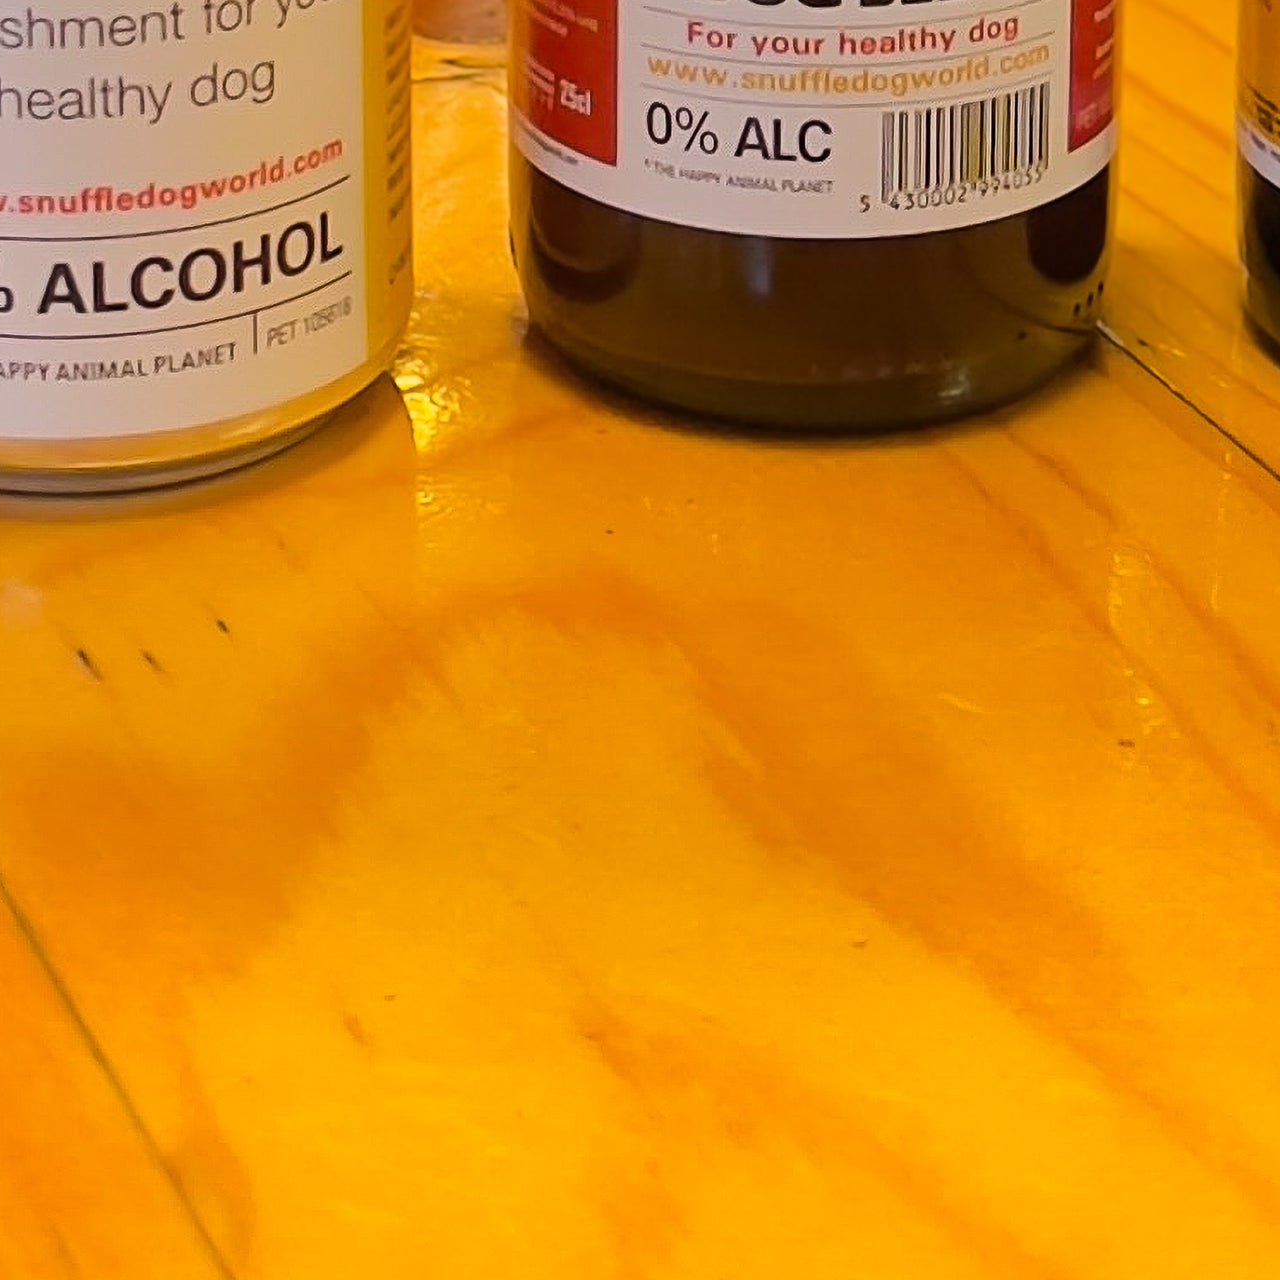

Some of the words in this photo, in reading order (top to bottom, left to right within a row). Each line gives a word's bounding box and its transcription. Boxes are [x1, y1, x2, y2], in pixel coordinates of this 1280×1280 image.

[686, 21, 736, 49] For
[751, 31, 825, 58] your
[838, 27, 956, 56] healthy
[968, 14, 1021, 43] dog
[190, 58, 277, 107] dog
[646, 43, 1051, 97] www.snuffledogworld.com
[645, 102, 719, 157] 0%
[734, 115, 832, 162] ALC
[726, 176, 777, 191] ANIMAL
[781, 179, 834, 193] PLANET
[37, 211, 344, 315] ALCOHOL
[56, 358, 148, 382] ANIMAL
[153, 342, 236, 373] PLANET
[266, 318, 297, 349] PET
